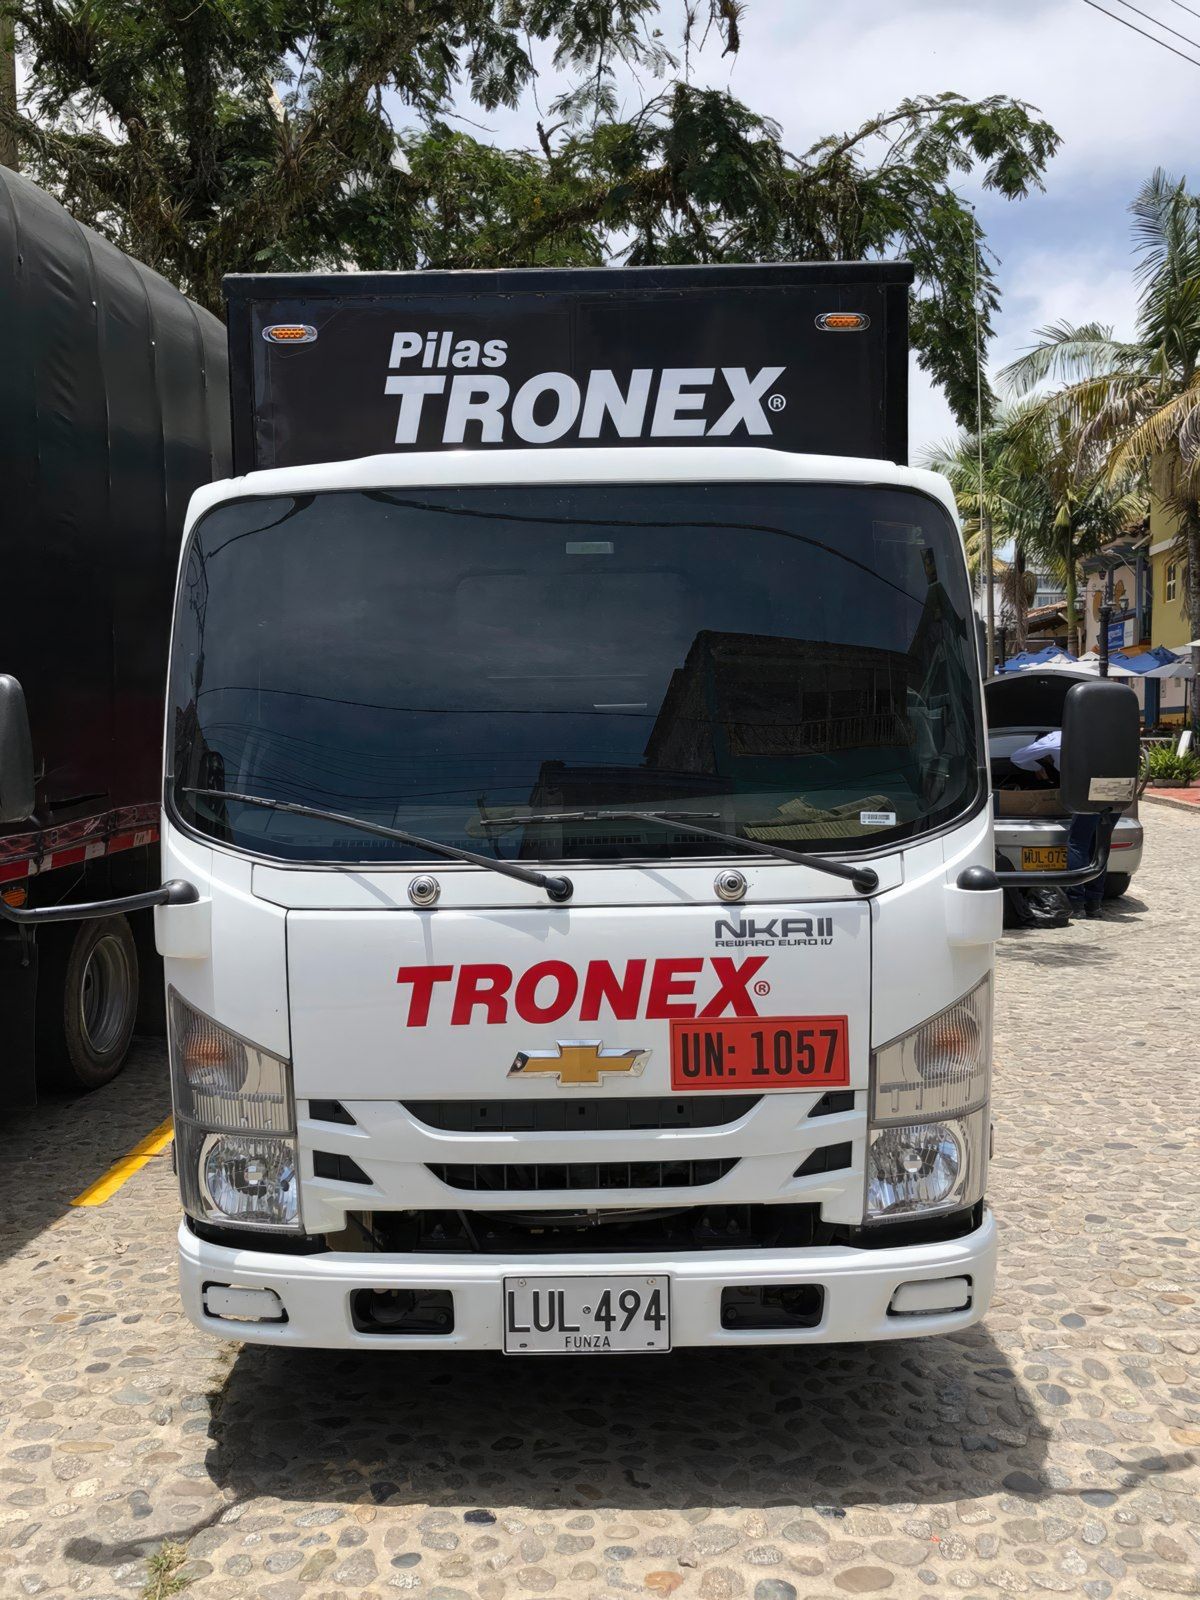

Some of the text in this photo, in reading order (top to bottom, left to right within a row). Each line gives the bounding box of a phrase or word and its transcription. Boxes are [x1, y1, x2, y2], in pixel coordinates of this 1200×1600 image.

[388, 331, 508, 368] Pilas
[778, 938, 818, 946] EURO
[682, 1029, 838, 1078] UN: 1057
[565, 1335, 611, 1348] FUNZA
